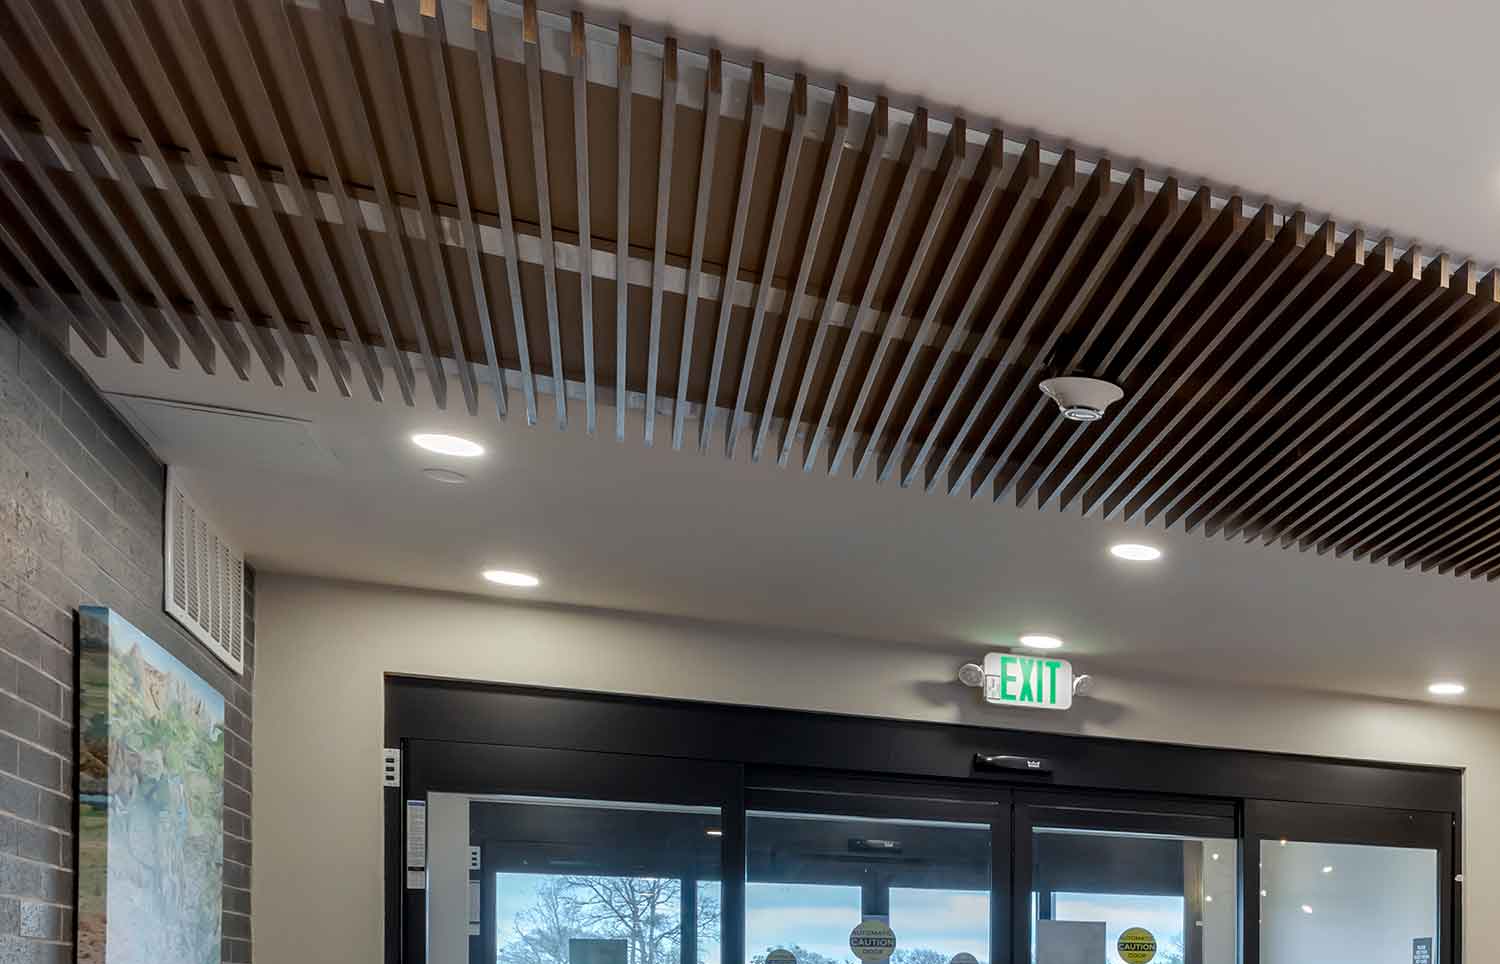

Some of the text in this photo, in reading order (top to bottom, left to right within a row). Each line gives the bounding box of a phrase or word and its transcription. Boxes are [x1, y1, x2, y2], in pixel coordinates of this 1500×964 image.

[1000, 656, 1062, 705] EXIT
[851, 938, 894, 947] CAUTION
[1118, 943, 1156, 951] CAUTION
